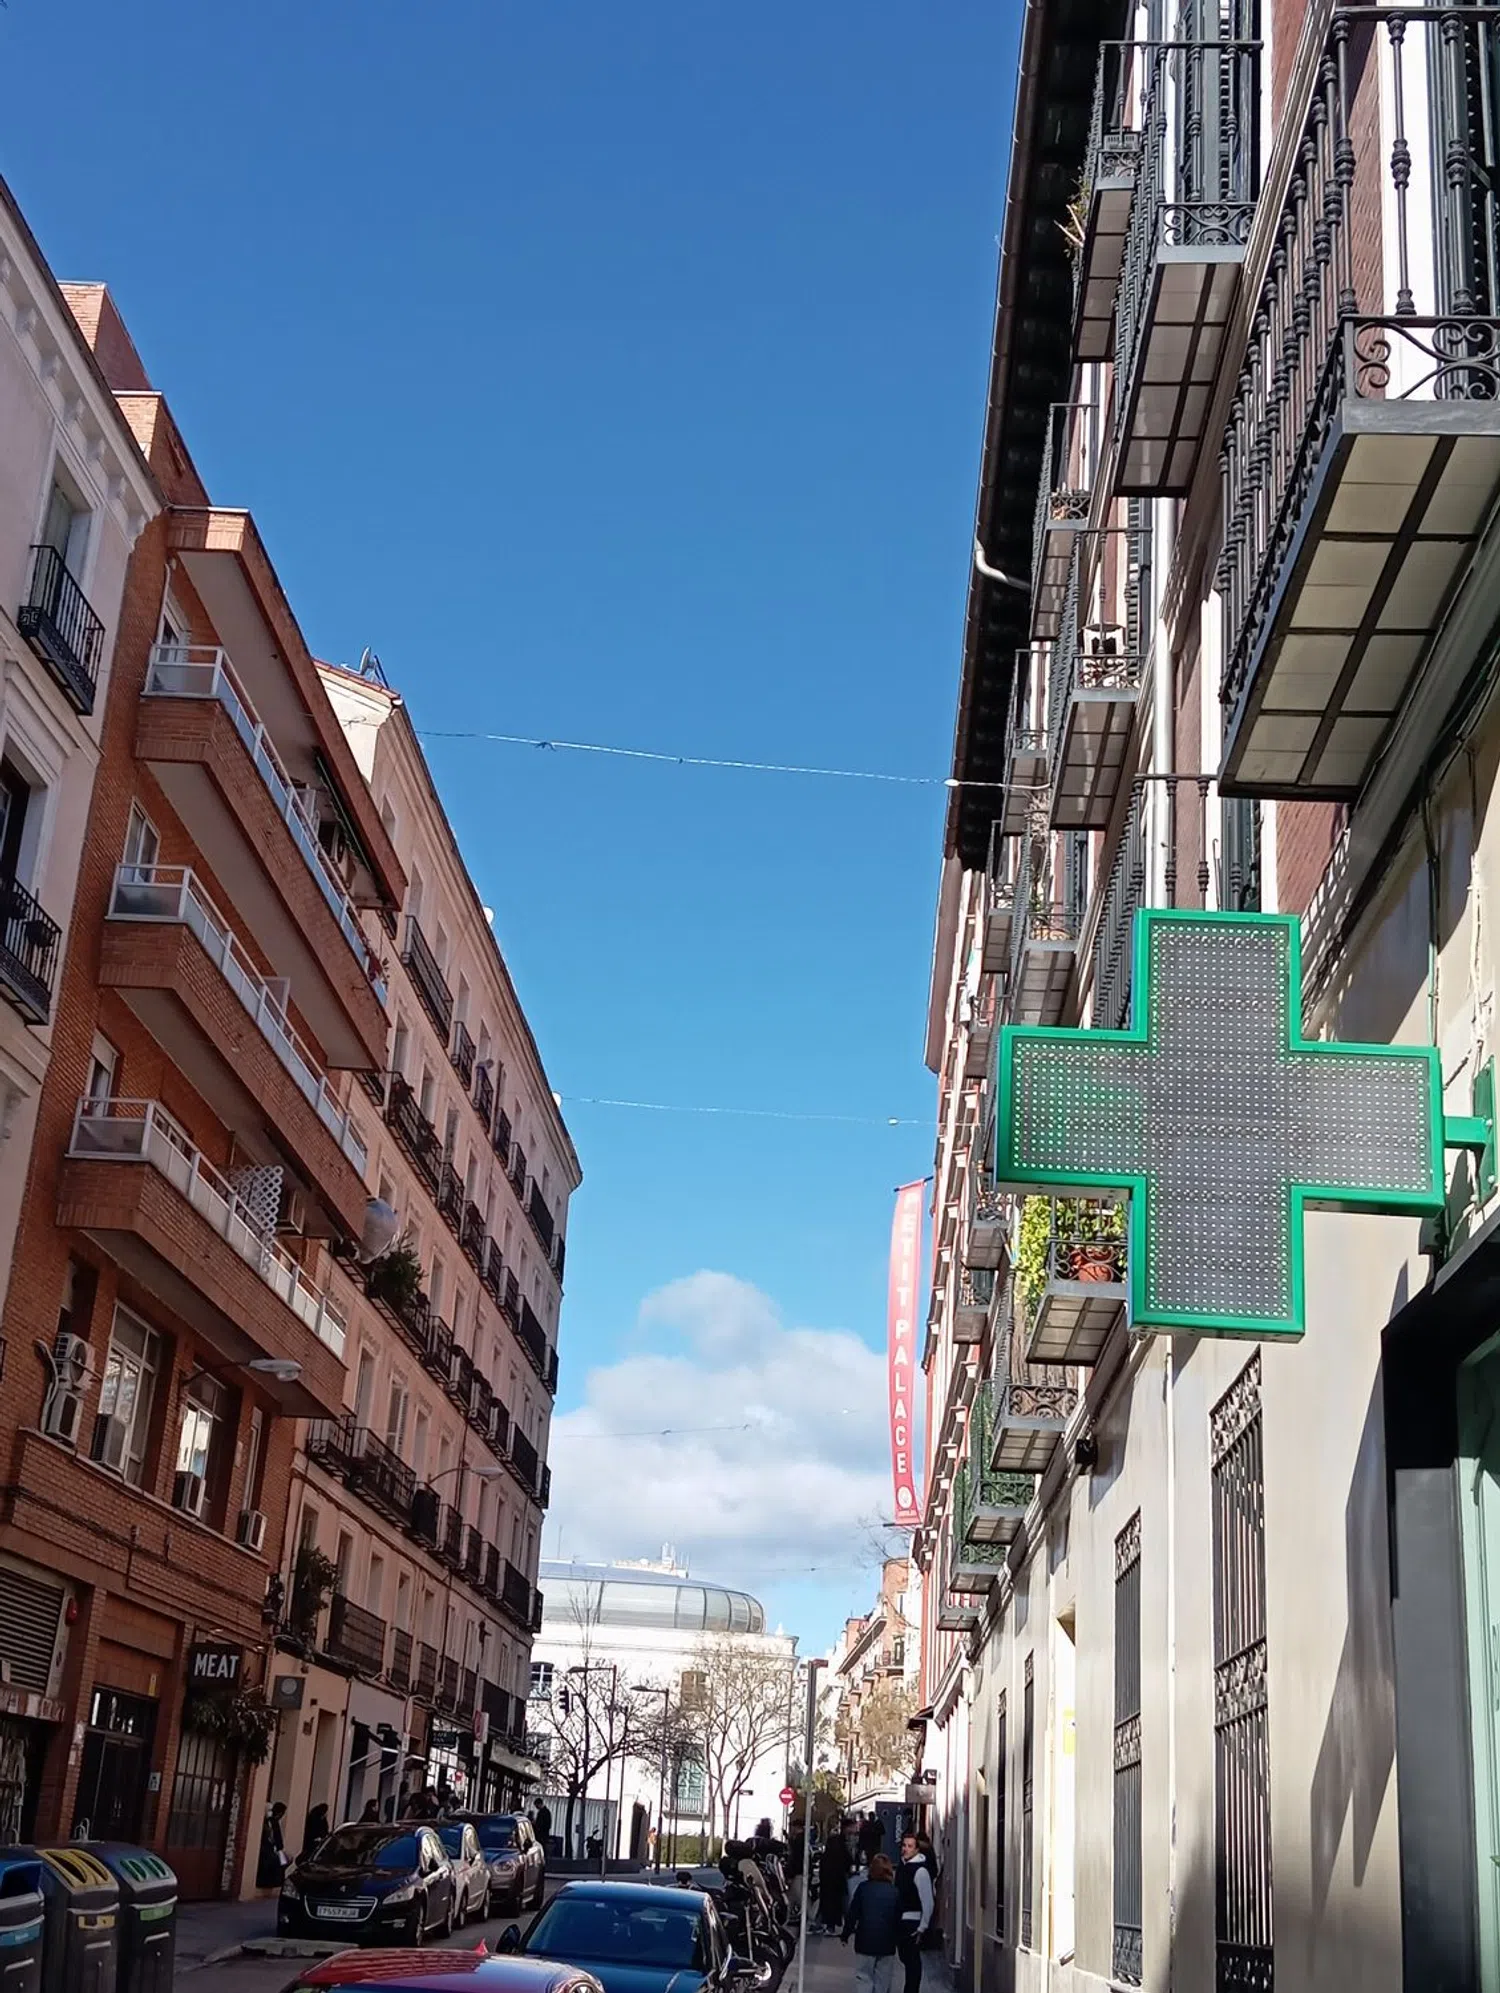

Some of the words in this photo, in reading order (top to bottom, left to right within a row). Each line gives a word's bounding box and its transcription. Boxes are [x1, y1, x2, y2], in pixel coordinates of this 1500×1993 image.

[896, 1192, 919, 1307] PETIT
[894, 1319, 910, 1474] PALACE
[194, 1653, 239, 1678] MEAT
